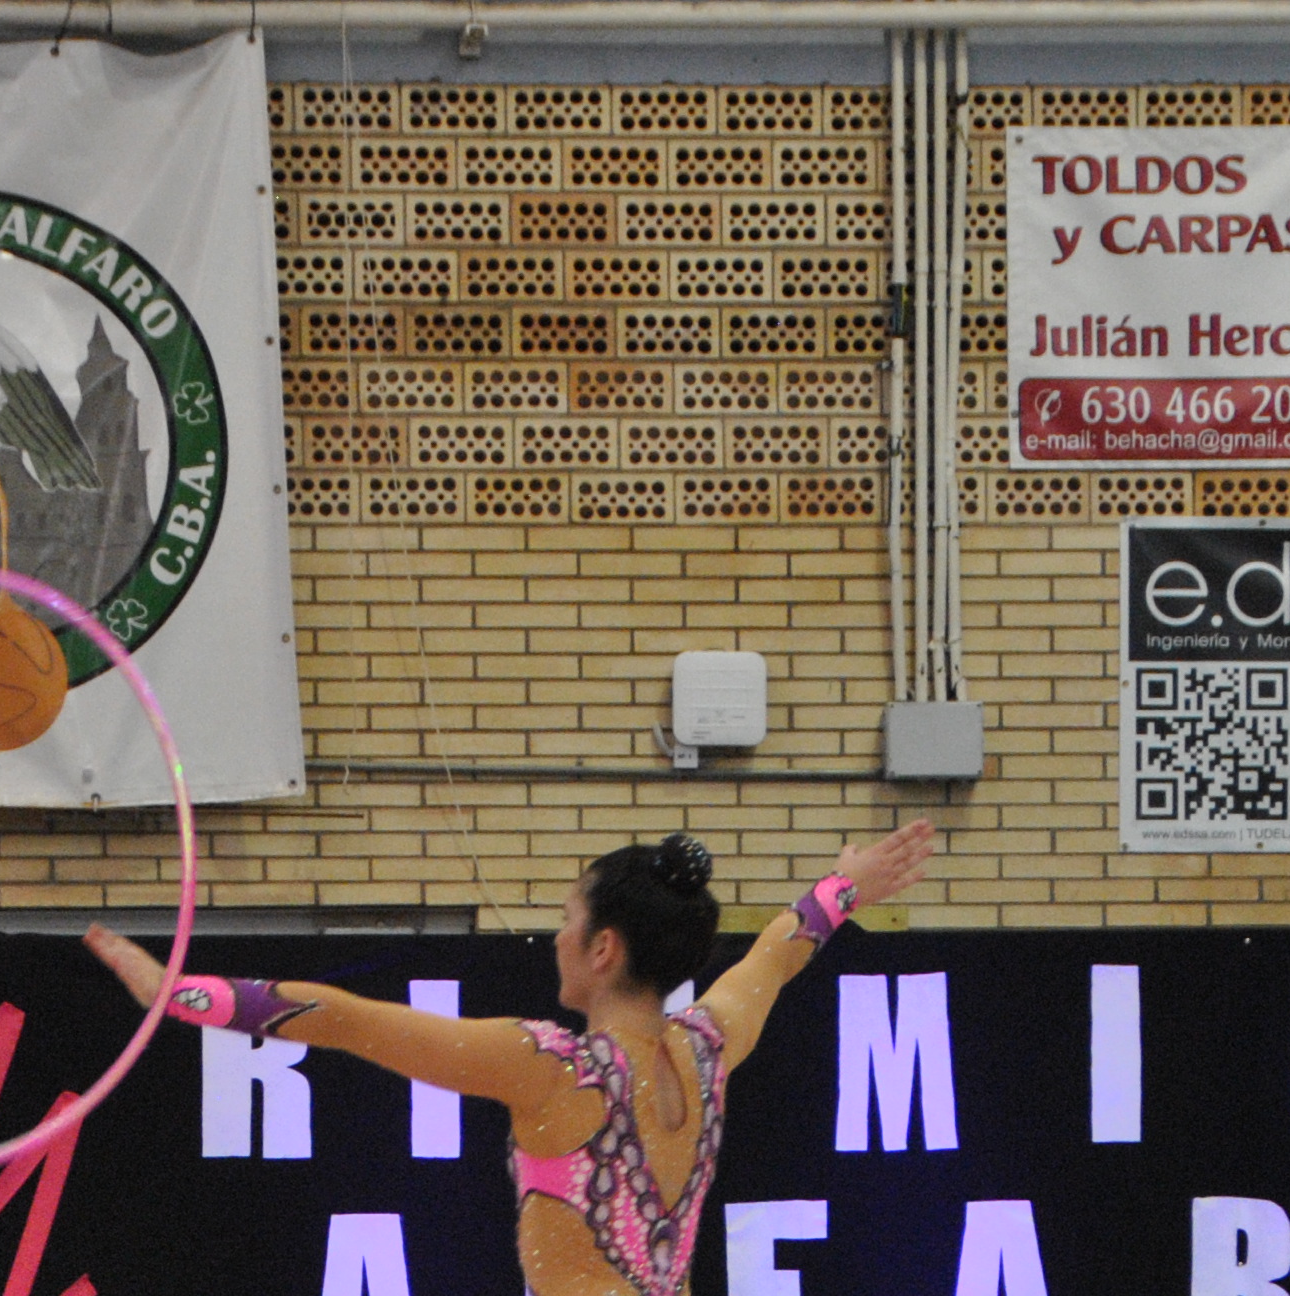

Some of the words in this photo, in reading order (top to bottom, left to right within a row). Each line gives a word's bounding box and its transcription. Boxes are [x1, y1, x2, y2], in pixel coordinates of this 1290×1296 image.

[1032, 154, 1248, 195] TOLDOS
[1051, 226, 1083, 265] y
[1029, 314, 1169, 358] Julián
[1080, 386, 1152, 424] 630
[1165, 386, 1236, 424] 466
[1026, 429, 1097, 450] e-mail:
[149, 449, 217, 587] C.B.A.
[1147, 632, 1230, 650] Ingeniería
[1239, 637, 1249, 651] y
